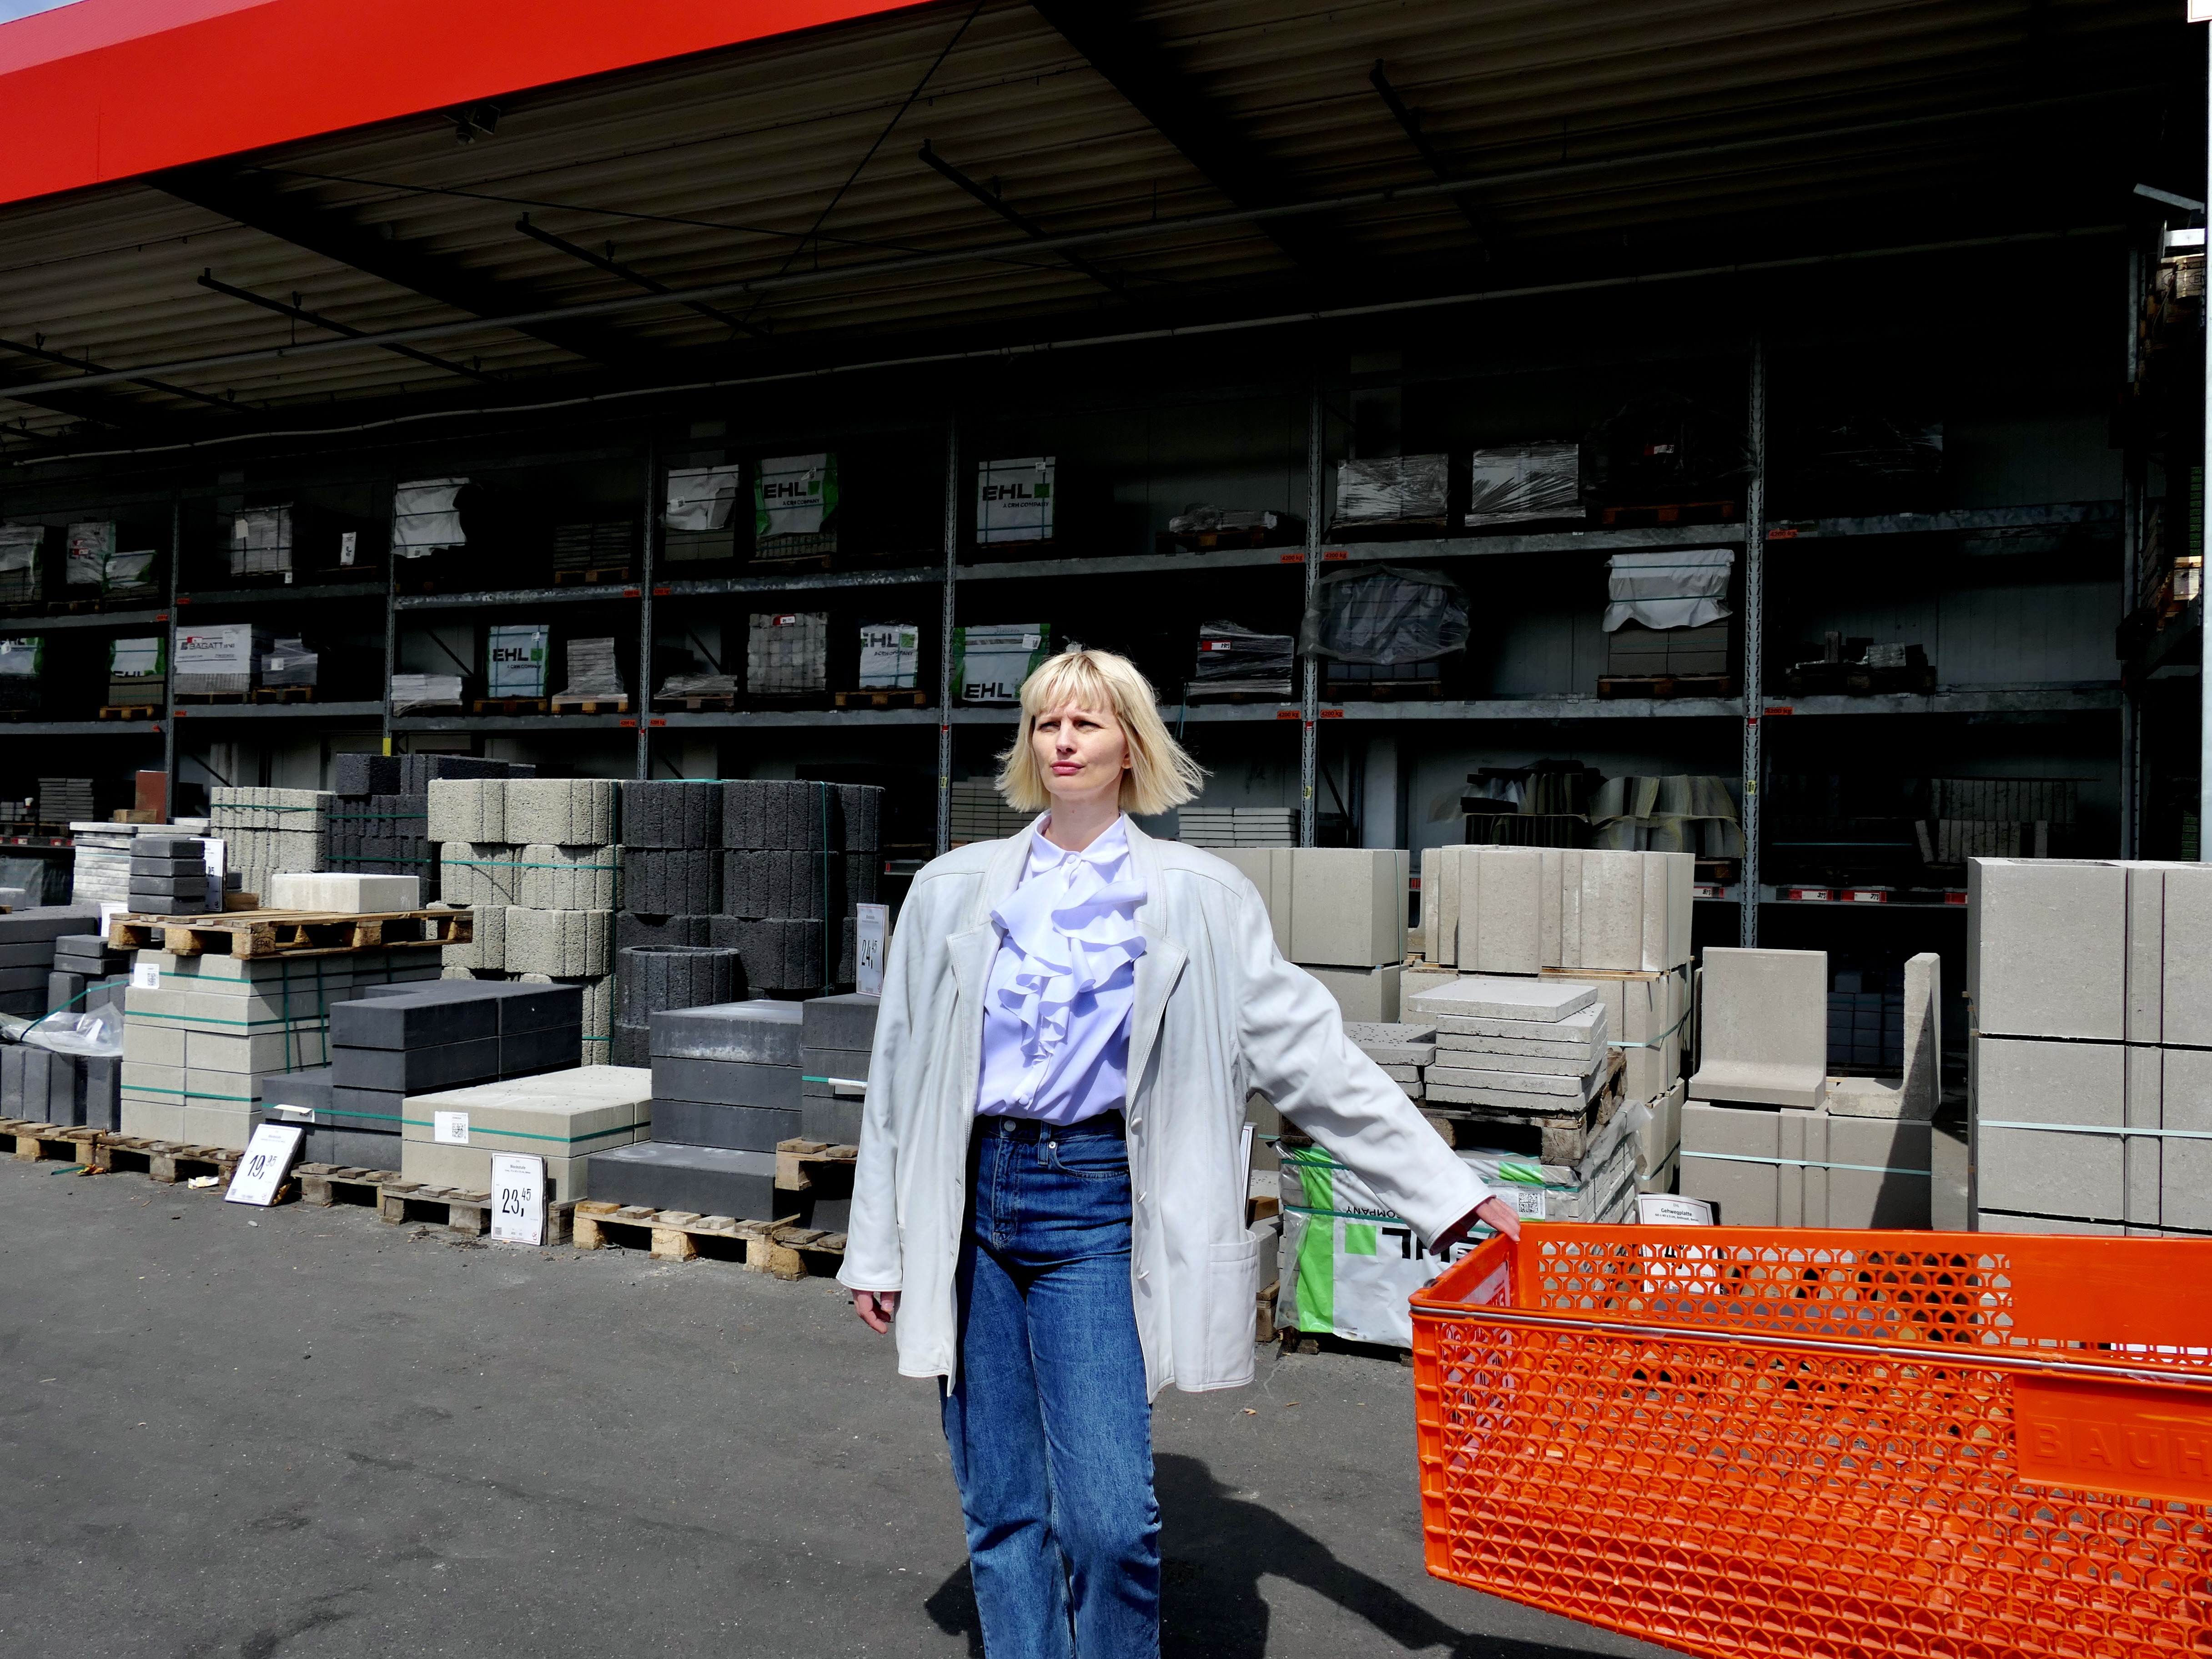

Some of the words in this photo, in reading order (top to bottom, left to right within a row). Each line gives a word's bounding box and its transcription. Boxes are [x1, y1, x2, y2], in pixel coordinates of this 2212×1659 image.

[764, 482, 807, 499] EHL
[982, 483, 1032, 501] EHL
[862, 633, 899, 647] EHL
[493, 648, 528, 661] EHL
[965, 683, 1012, 698] EHL
[1347, 1206, 1401, 1219] OMPANY
[1661, 1208, 1692, 1217] Gehwegplatte
